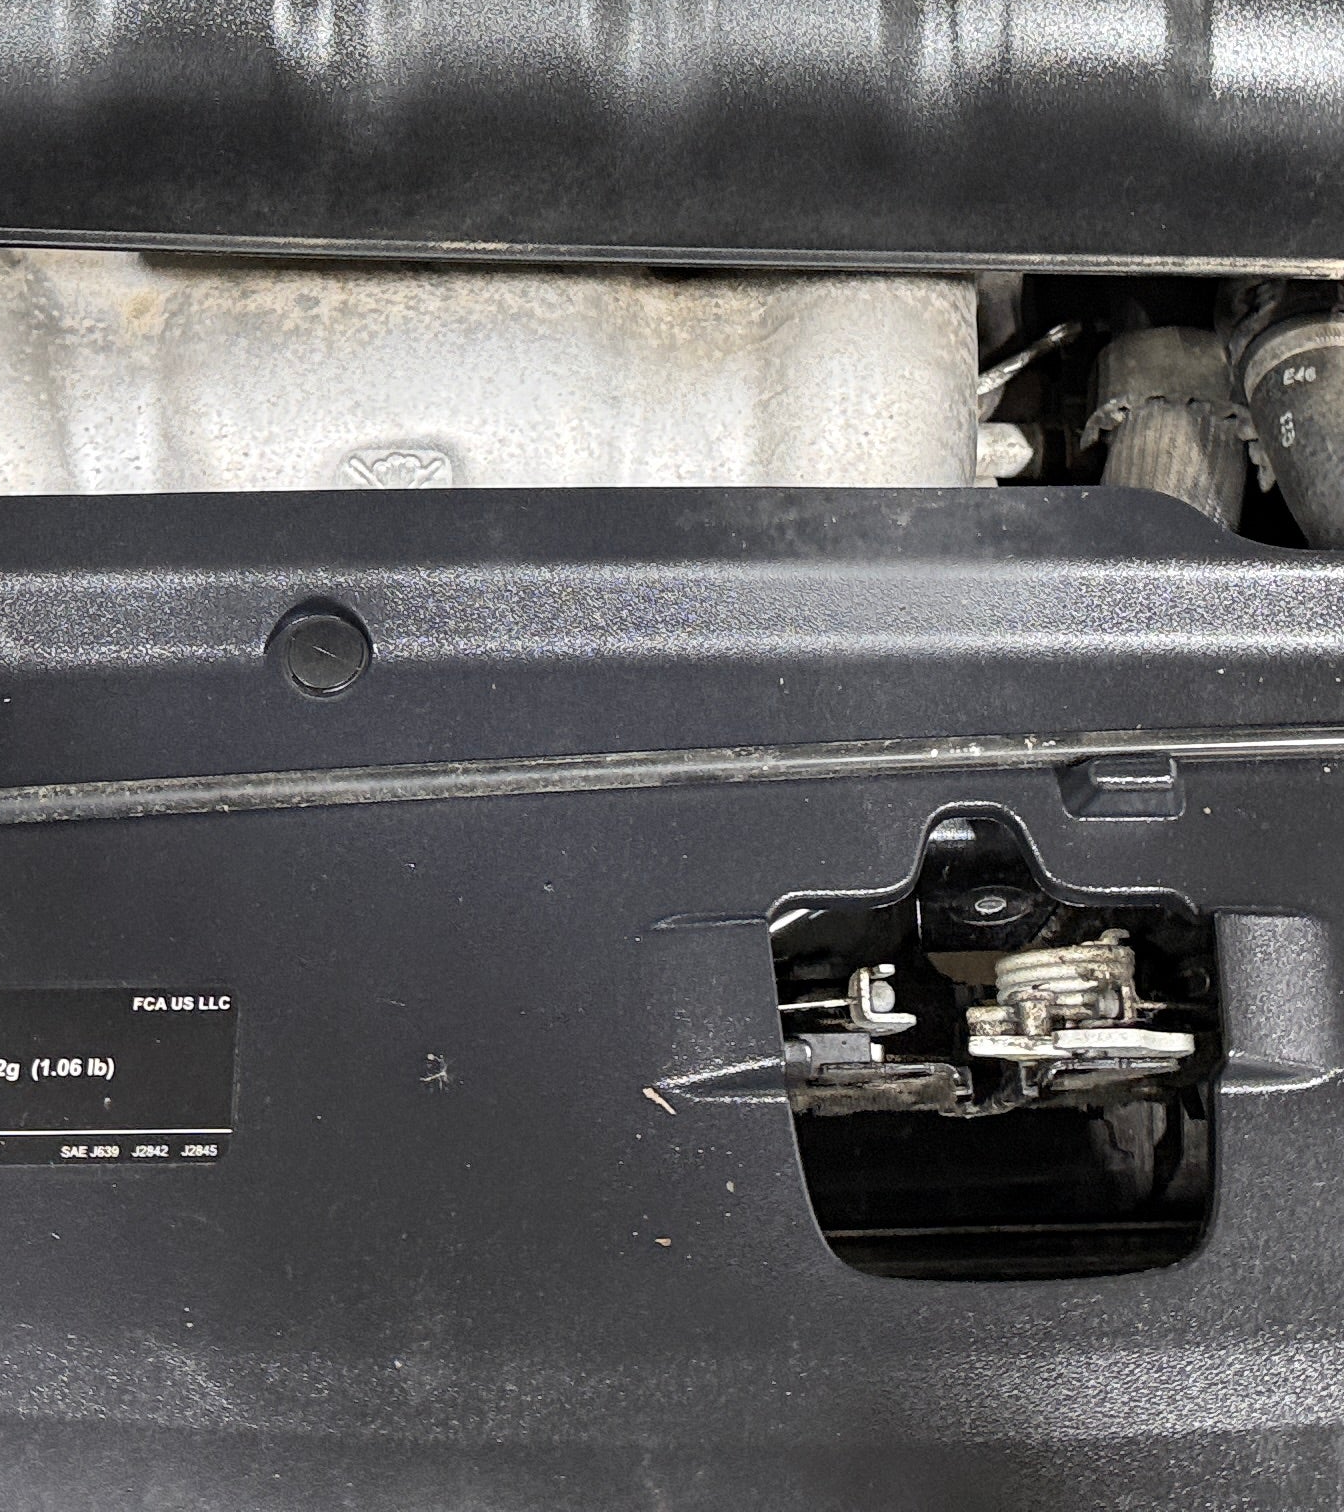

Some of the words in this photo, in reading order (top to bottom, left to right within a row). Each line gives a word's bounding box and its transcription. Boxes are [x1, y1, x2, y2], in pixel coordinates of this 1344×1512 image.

[132, 996, 168, 1011] FCA
[171, 996, 195, 1010] US
[199, 996, 231, 1011] LLC
[31, 1058, 82, 1081] (1.06
[86, 1058, 115, 1080] lb)
[60, 1145, 87, 1158] SAE
[89, 1144, 120, 1158] J639
[131, 1144, 170, 1157] J2842
[181, 1144, 218, 1157] J2845
